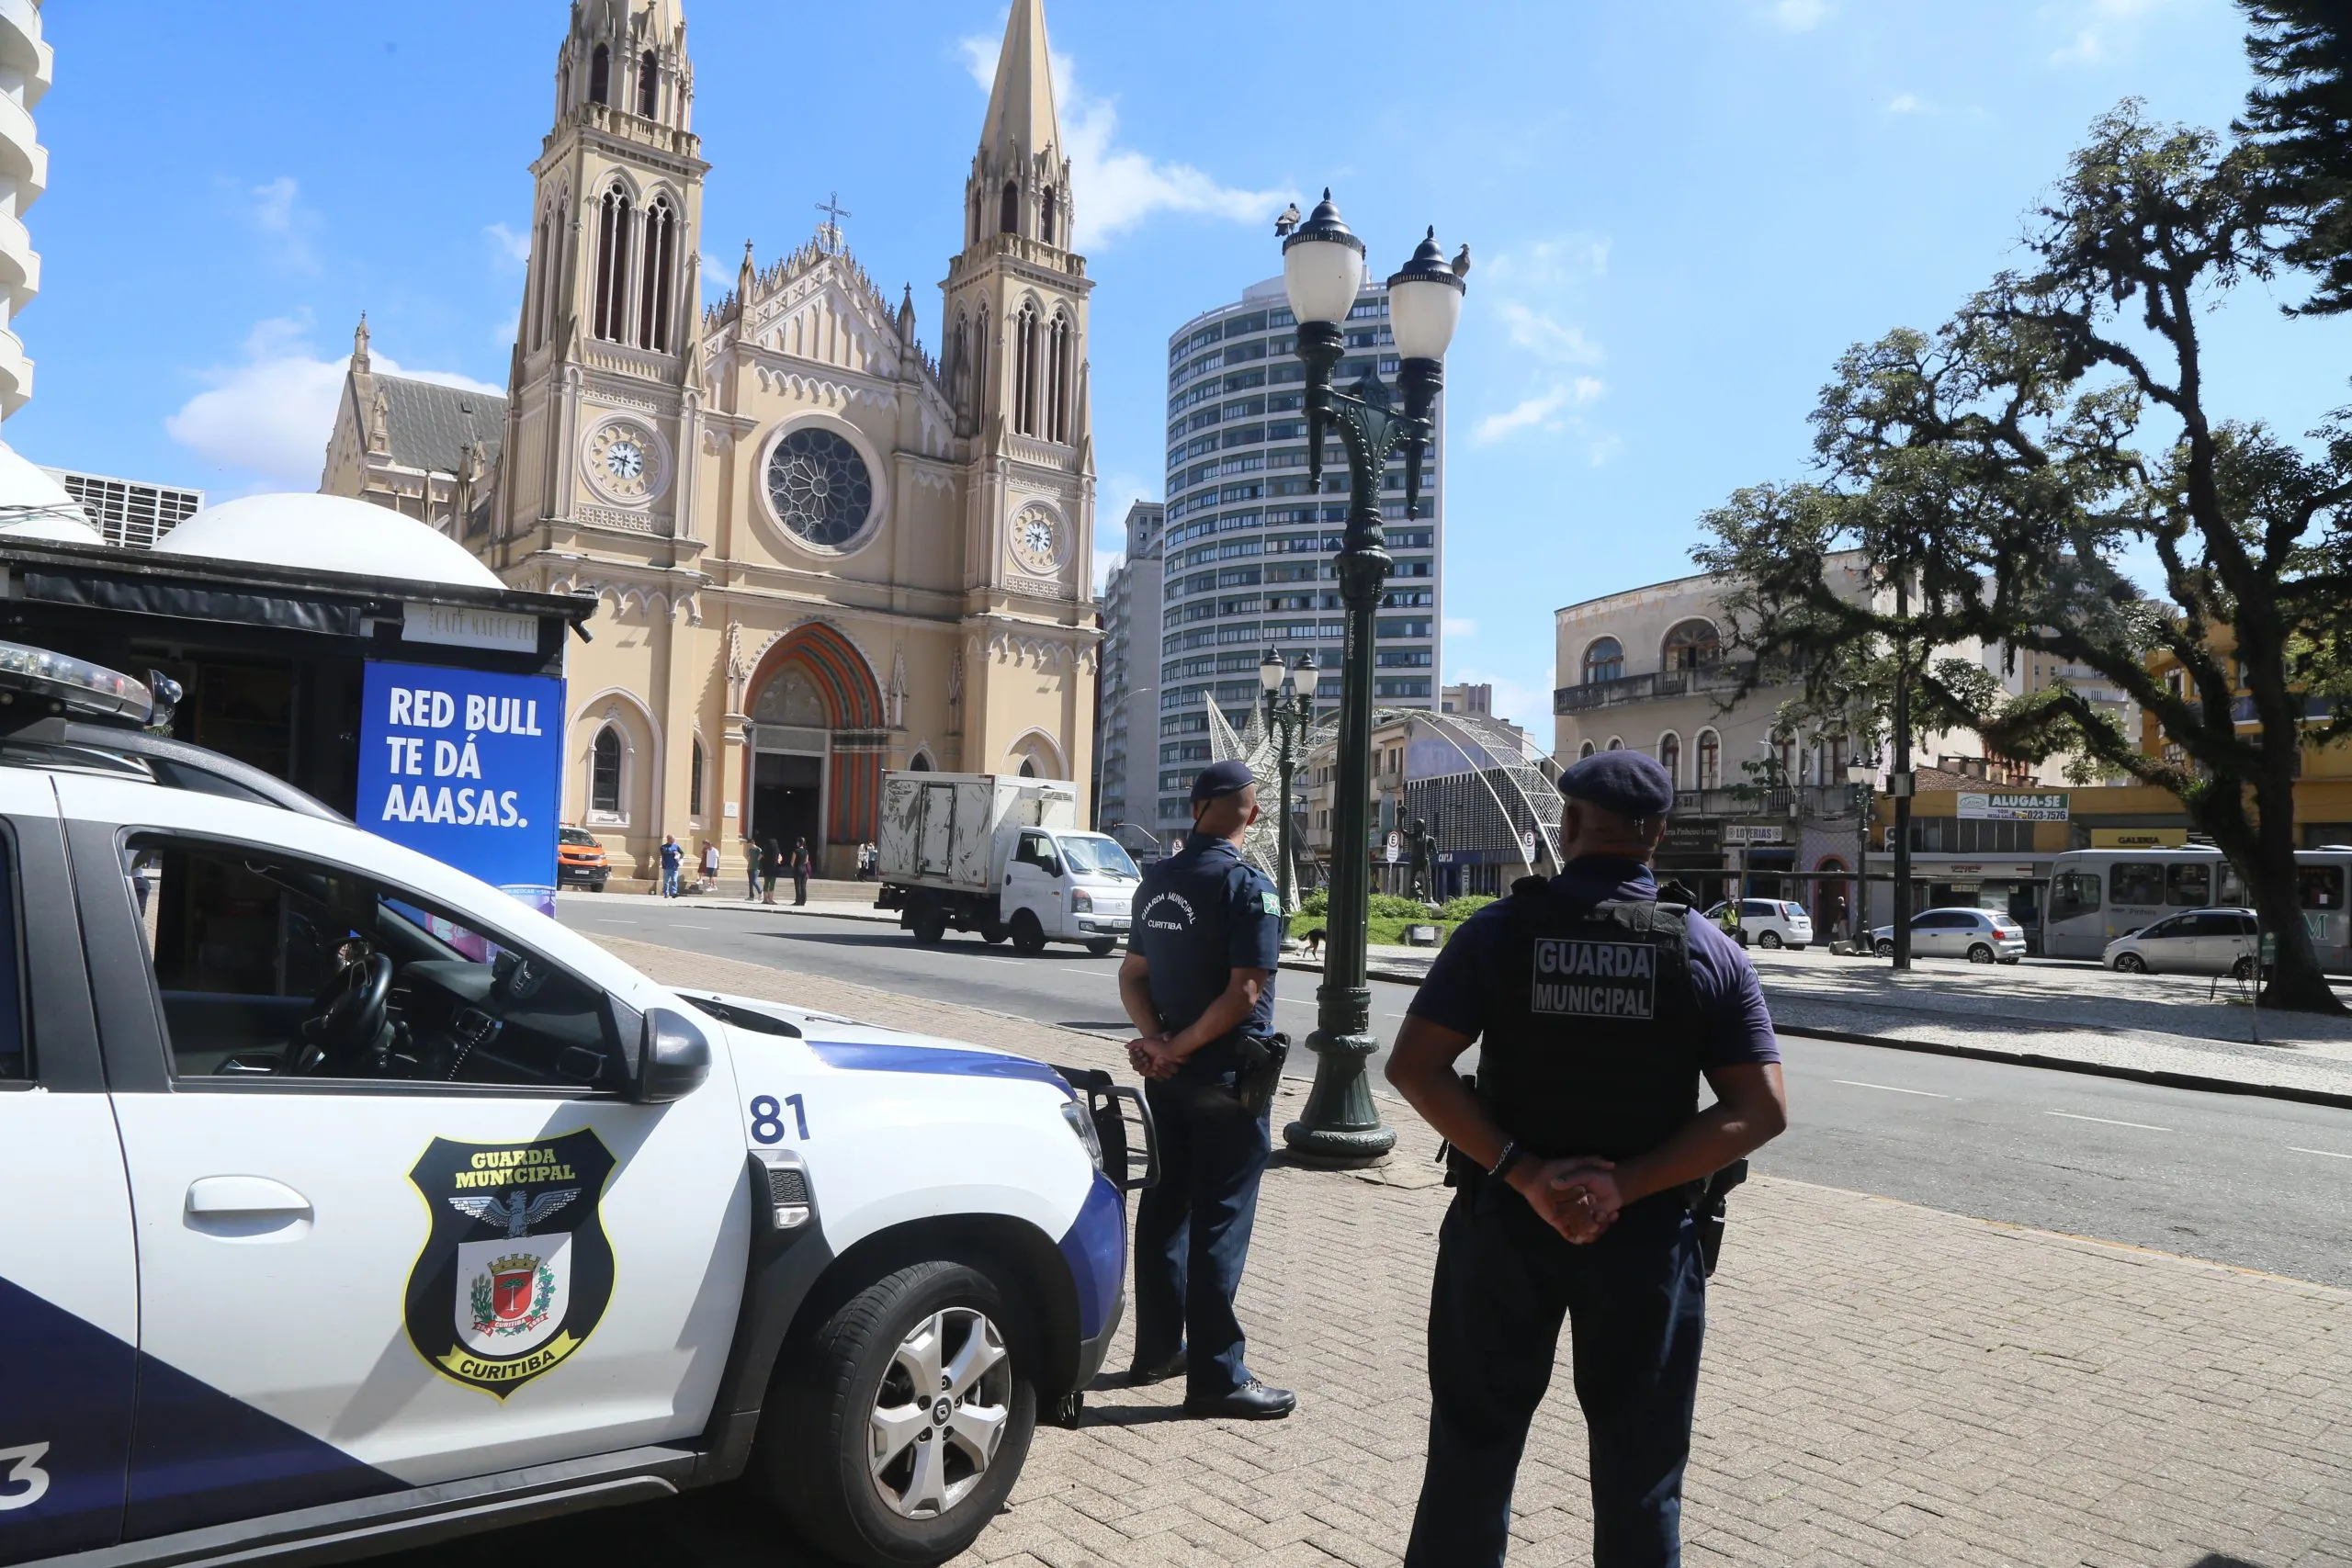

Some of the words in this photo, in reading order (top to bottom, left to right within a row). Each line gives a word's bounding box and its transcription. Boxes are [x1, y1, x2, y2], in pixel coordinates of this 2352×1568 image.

[389, 687, 455, 728] RED
[465, 694, 542, 736] BULL
[386, 736, 424, 775] TE
[434, 733, 481, 779] DÁ
[381, 784, 528, 828] AAASAS.
[1991, 795, 2061, 807] ALUGA-SE
[2118, 836, 2160, 844] GALERIA
[1141, 894, 1165, 920] GUARDA
[1167, 891, 1196, 925] MUNICIPAL
[1148, 919, 1182, 931] CURITIBA
[1538, 942, 1651, 978] GUARDA
[1536, 984, 1650, 1016] MUNICIPAL
[750, 1093, 810, 1145] 81
[470, 1148, 557, 1169] GUARDA
[455, 1165, 575, 1189] MUNICIPAL
[494, 1317, 526, 1328] CURITIBA
[528, 1315, 545, 1328] 1693
[460, 1348, 556, 1380] CURITIBA
